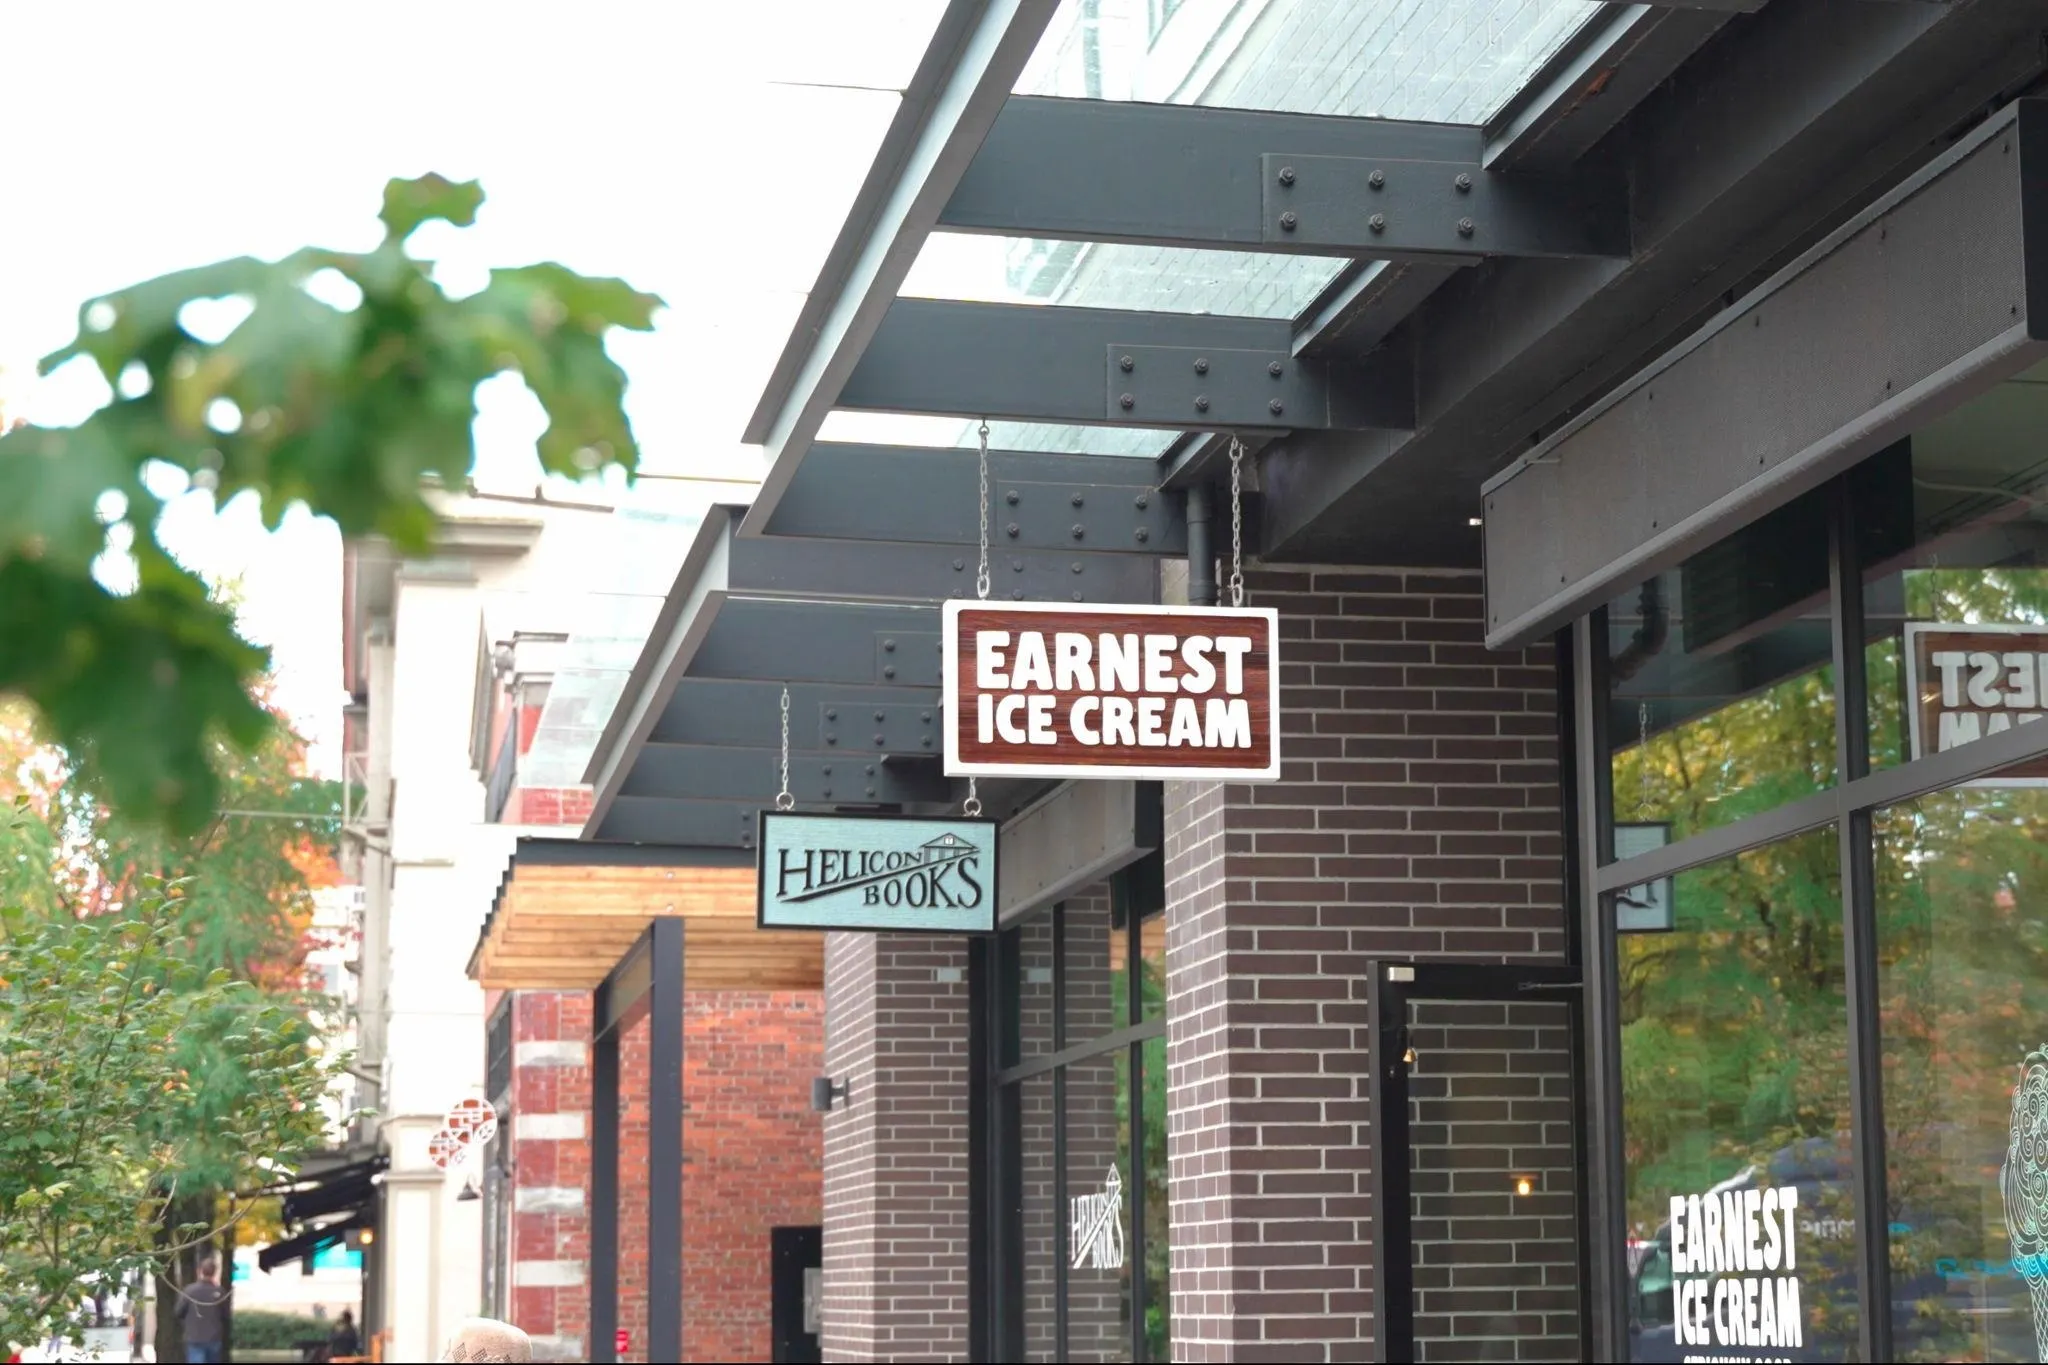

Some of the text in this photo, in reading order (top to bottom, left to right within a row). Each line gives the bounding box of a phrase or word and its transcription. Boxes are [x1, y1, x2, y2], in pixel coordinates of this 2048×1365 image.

[976, 631, 1252, 695] EARNEST
[977, 693, 1252, 749] ICE CREAM
[776, 848, 923, 898] HELICON
[861, 857, 983, 908] BOOKS
[1670, 1186, 1798, 1273] EARNEST
[1673, 1277, 1803, 1348] ICE CREAM
